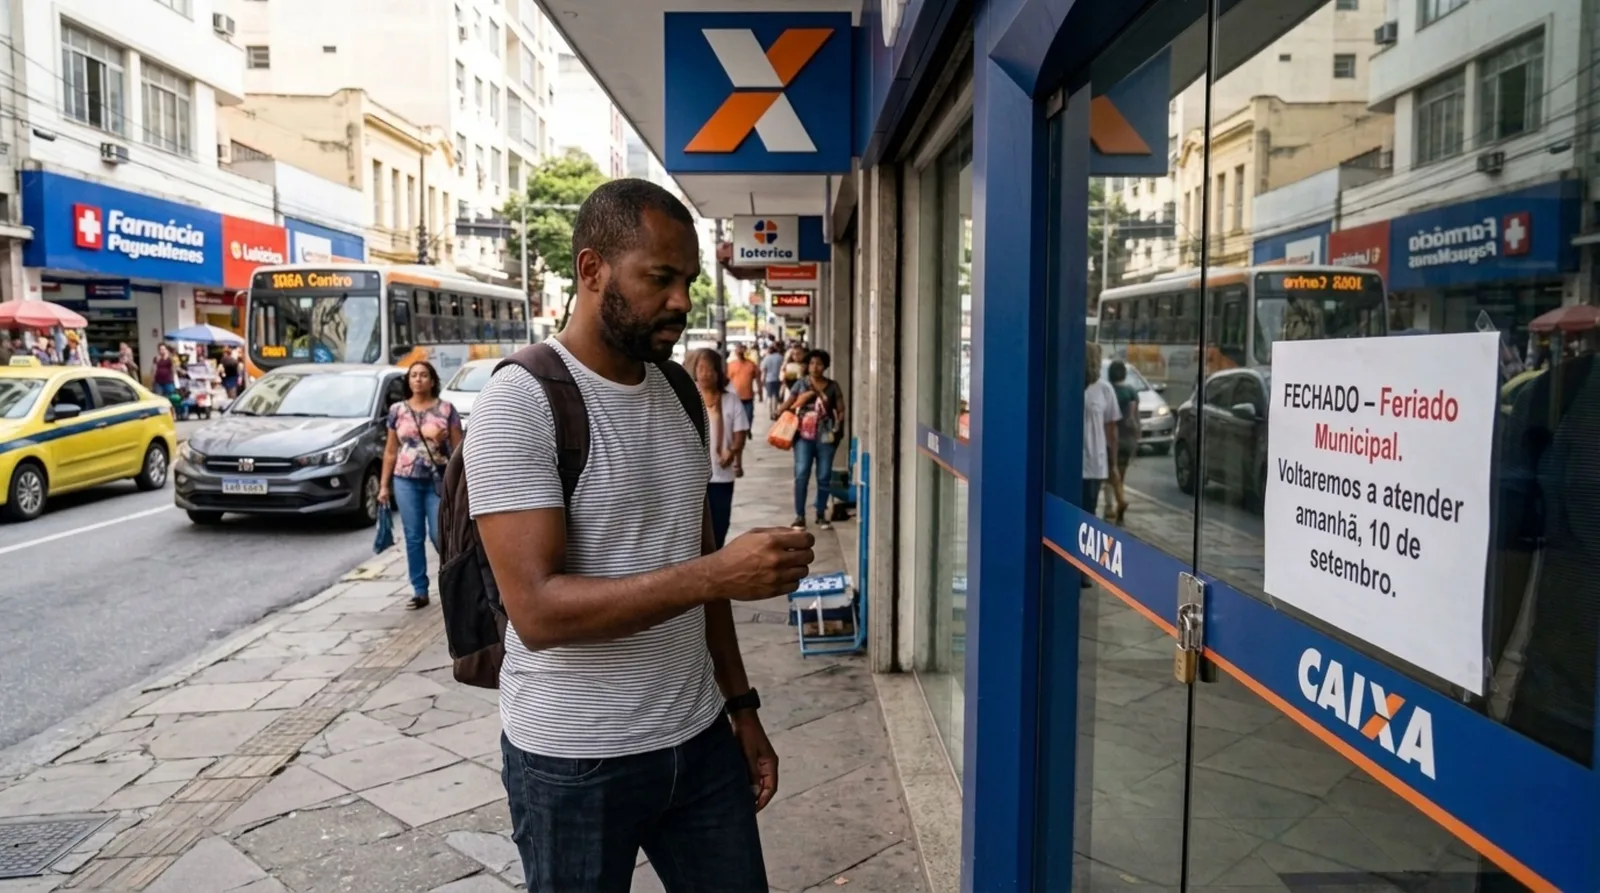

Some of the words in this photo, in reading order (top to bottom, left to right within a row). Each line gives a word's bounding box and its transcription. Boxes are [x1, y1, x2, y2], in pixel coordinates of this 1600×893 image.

[108, 209, 204, 247] Farmácia
[1284, 383, 1360, 413] FECHADO
[1380, 387, 1459, 422] Feriado
[1314, 422, 1403, 464] Municipal.
[1278, 457, 1362, 500] Voltaremos
[1367, 482, 1378, 504] a
[1383, 482, 1465, 523] atender
[1078, 522, 1124, 578] CAIXA
[1296, 504, 1362, 547] amanhã,
[1369, 519, 1391, 550] 10
[1396, 528, 1421, 560] de
[1309, 548, 1397, 598] setembro.
[1297, 647, 1436, 780] CAIXA
